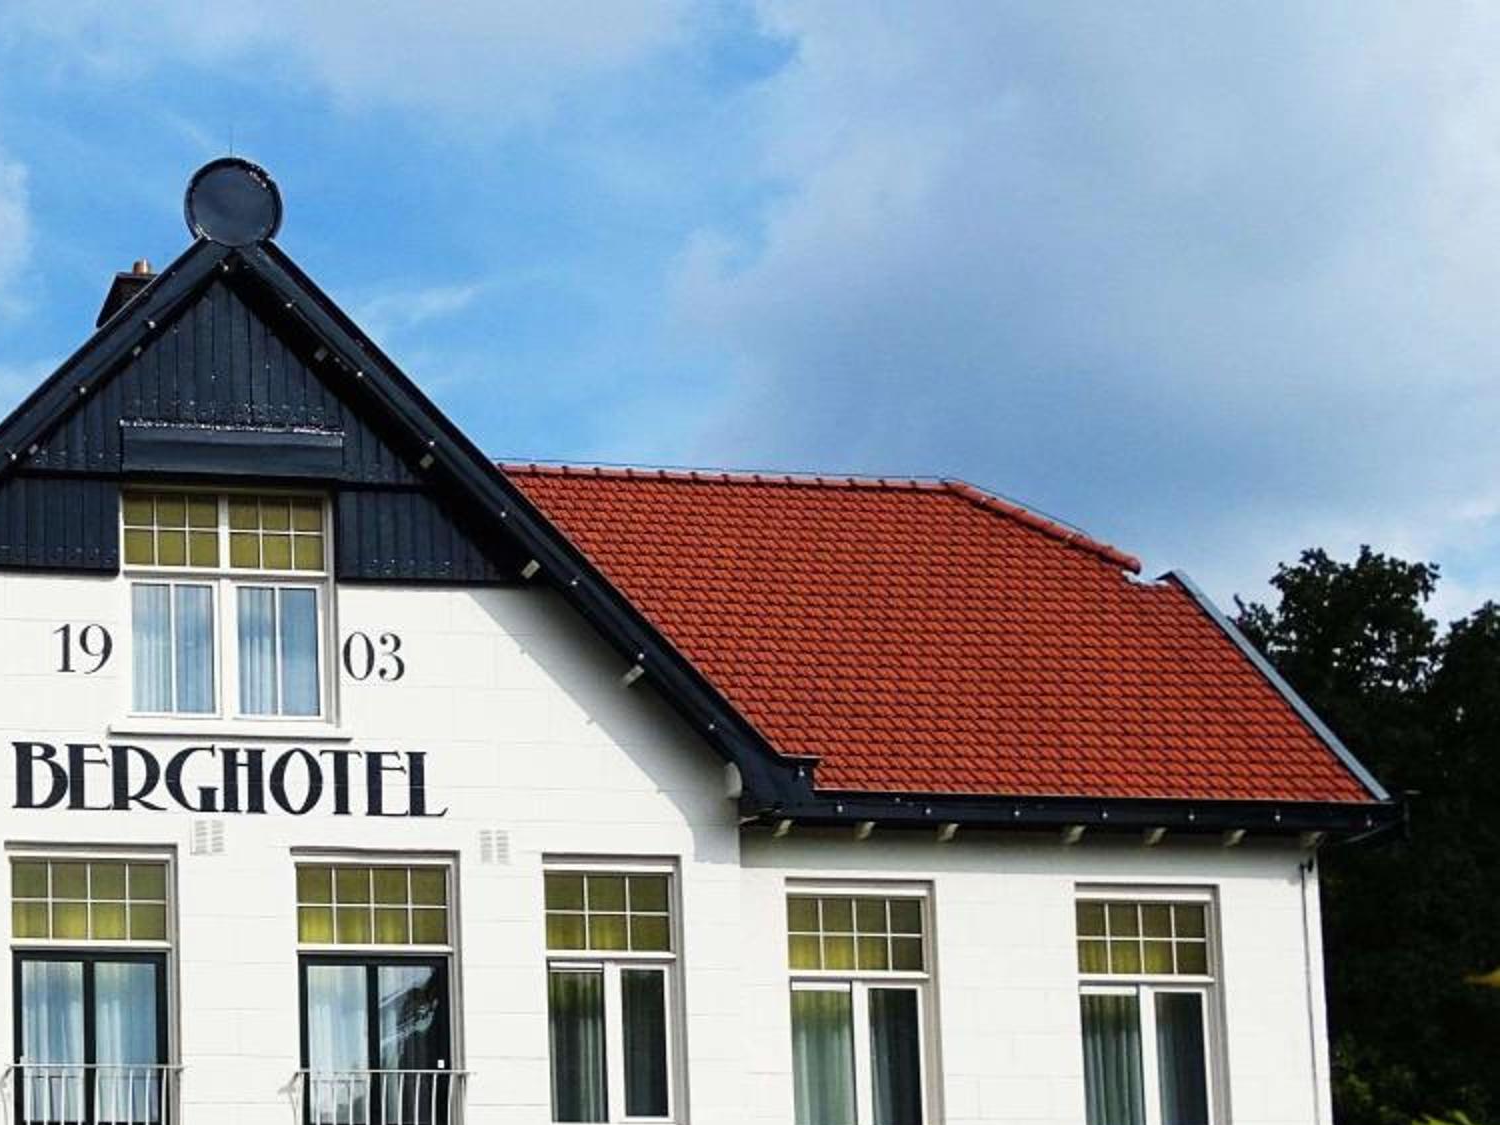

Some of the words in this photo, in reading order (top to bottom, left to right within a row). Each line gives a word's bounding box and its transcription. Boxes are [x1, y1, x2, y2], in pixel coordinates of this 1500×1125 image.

[53, 623, 113, 673] 19
[343, 632, 406, 681] 03
[11, 741, 448, 817] BERGHOTEL
